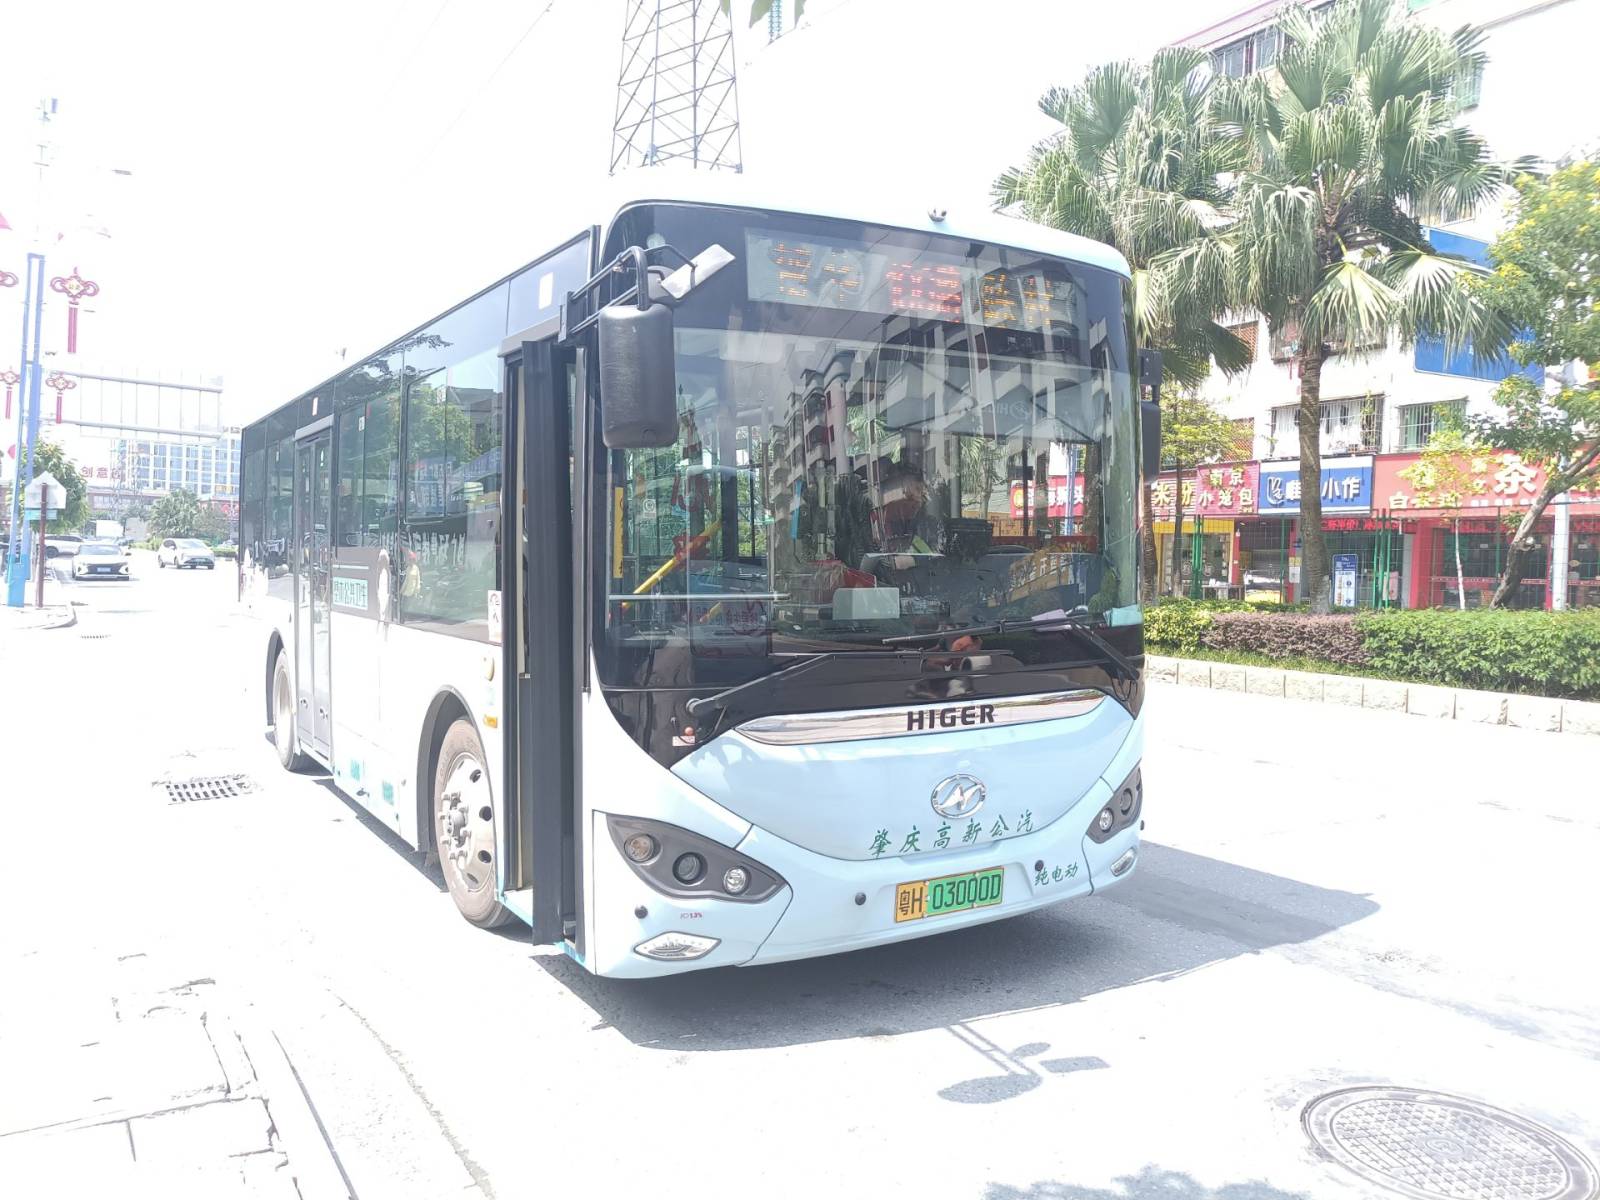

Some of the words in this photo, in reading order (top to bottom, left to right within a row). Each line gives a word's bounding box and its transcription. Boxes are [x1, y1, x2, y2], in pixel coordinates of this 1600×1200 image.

[1198, 488, 1254, 508] 小笼包
[907, 703, 995, 732] HIGER
[868, 809, 1035, 857] 肇庆高新公汽
[1034, 862, 1079, 887] 纯电动
[931, 873, 1002, 911] 03000D
